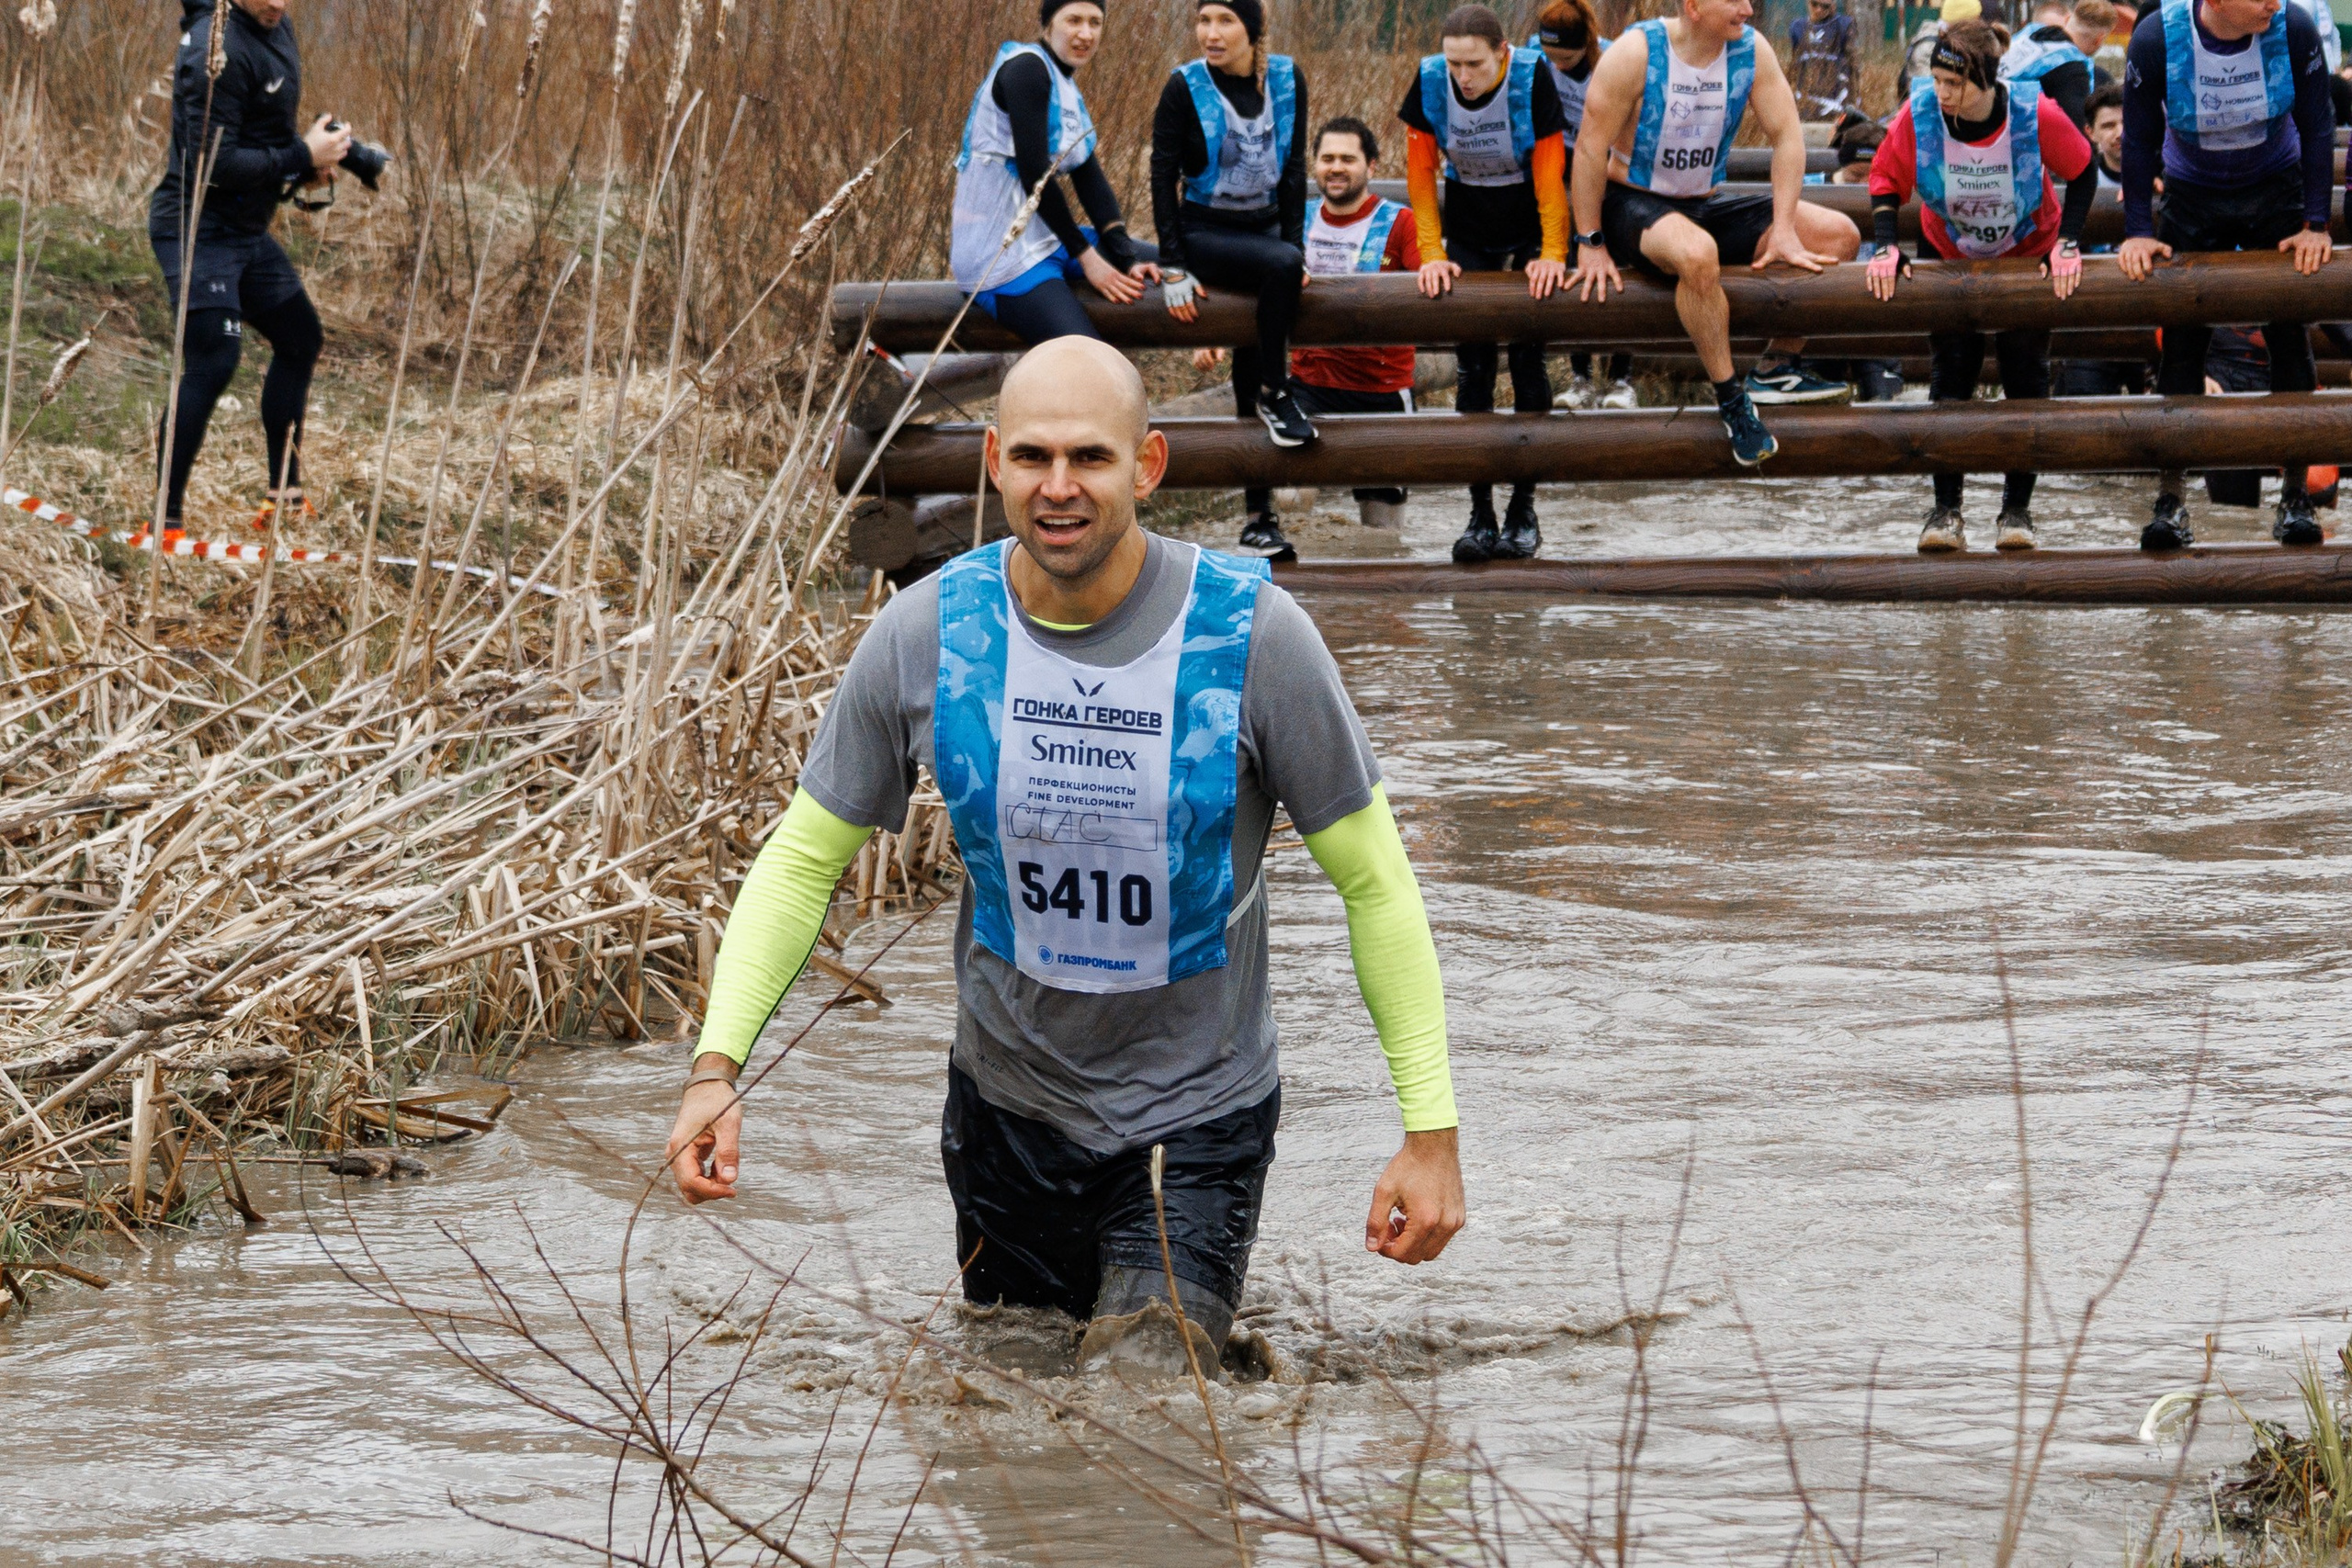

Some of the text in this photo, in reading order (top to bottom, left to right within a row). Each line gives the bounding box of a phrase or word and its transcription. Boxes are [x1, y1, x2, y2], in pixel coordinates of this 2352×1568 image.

[2199, 70, 2260, 85] ГОНКА ГЕРОЕВ
[2225, 94, 2264, 106] НОВИКОМ
[1456, 137, 1499, 150] Sminex
[1661, 146, 1714, 171] 5660
[1949, 164, 2009, 175] ГОНКА ГЕРОЕВ
[1957, 177, 2001, 191] Sminex
[1012, 697, 1163, 729] ГОНКА ГЕРОЕВ
[1030, 734, 1137, 772] Sminex
[1028, 776, 1136, 796] ПЕРФЕКЦИОНИСТЫ
[1027, 791, 1136, 810] FINE DEVELOPMENT
[1011, 802, 1113, 842] СТАС
[1018, 860, 1153, 927] 5410
[1057, 953, 1137, 971] ГАЗПРОМБАНК
